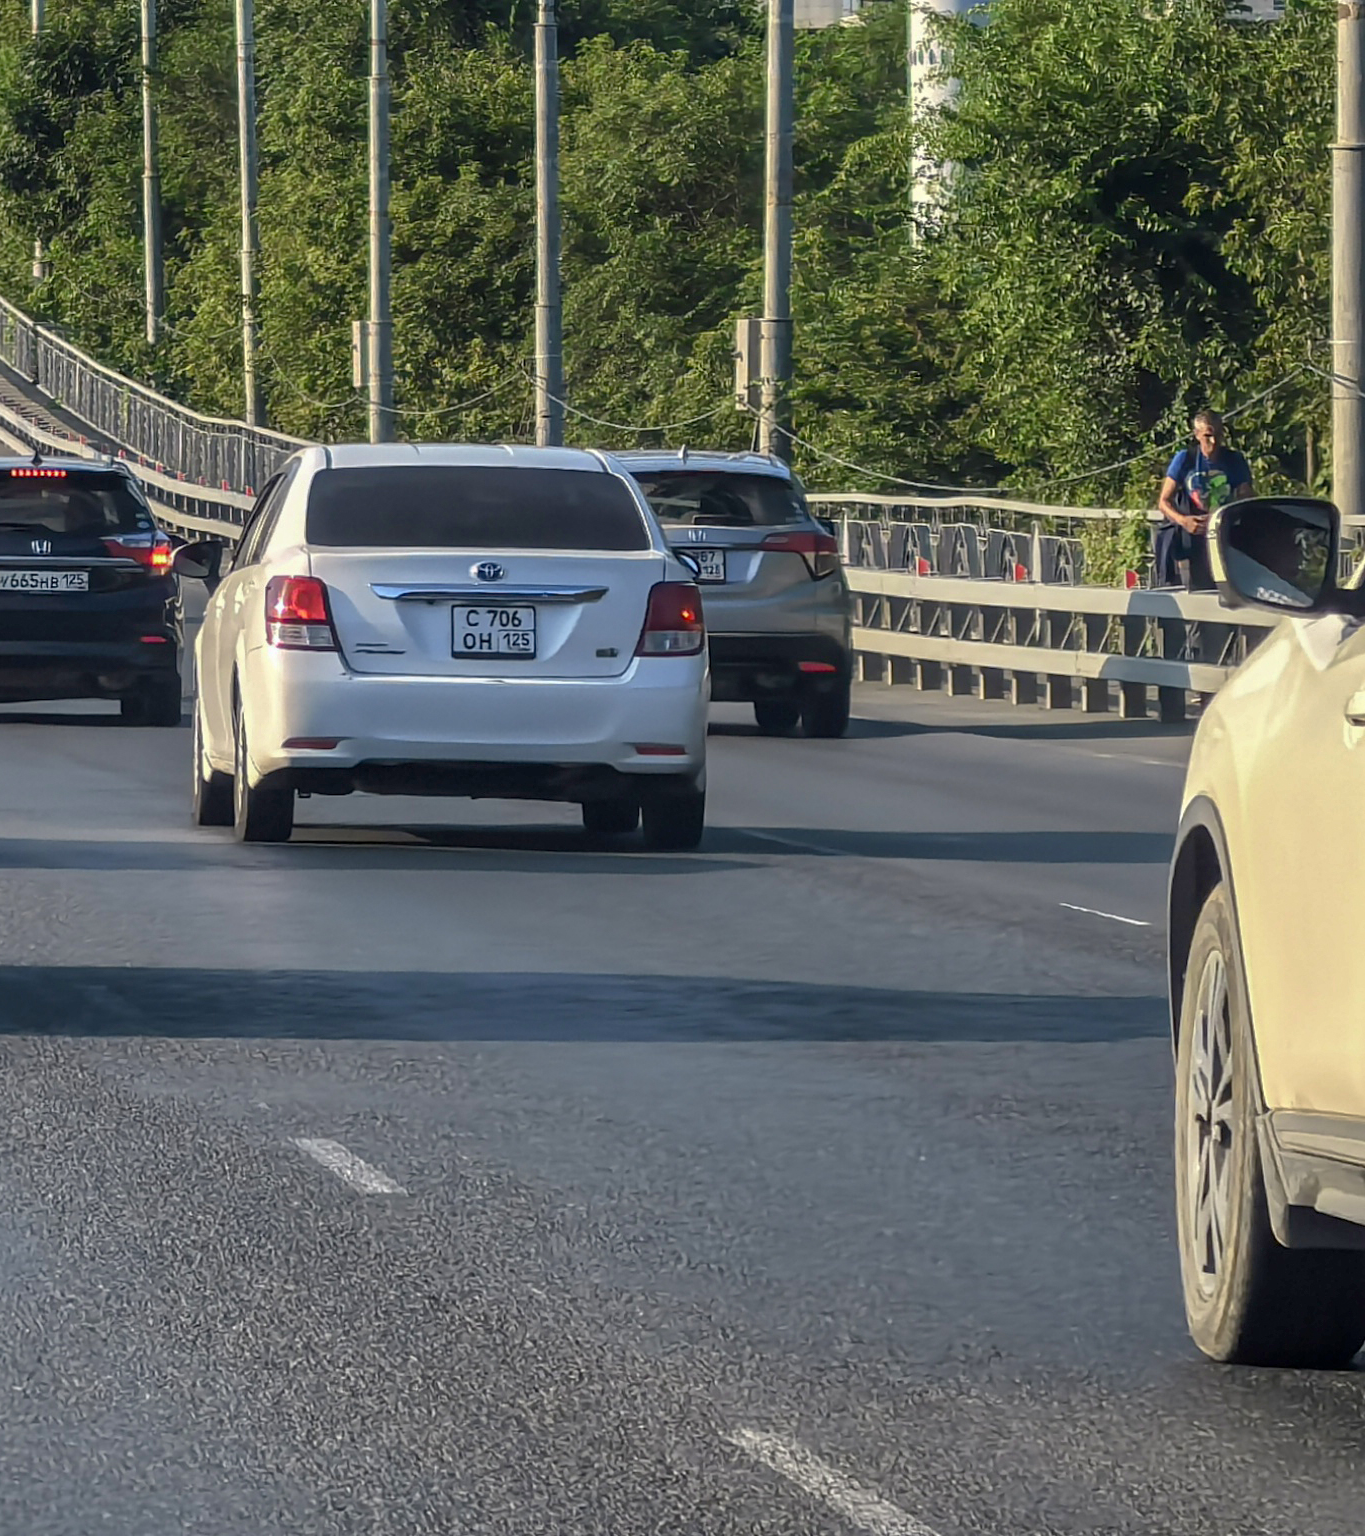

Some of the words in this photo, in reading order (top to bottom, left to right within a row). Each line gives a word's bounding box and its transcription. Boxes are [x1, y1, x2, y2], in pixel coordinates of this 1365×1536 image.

[63, 574, 85, 586] 125
[487, 610, 522, 627] 706
[463, 633, 493, 649] ОН
[502, 632, 530, 648] 125
